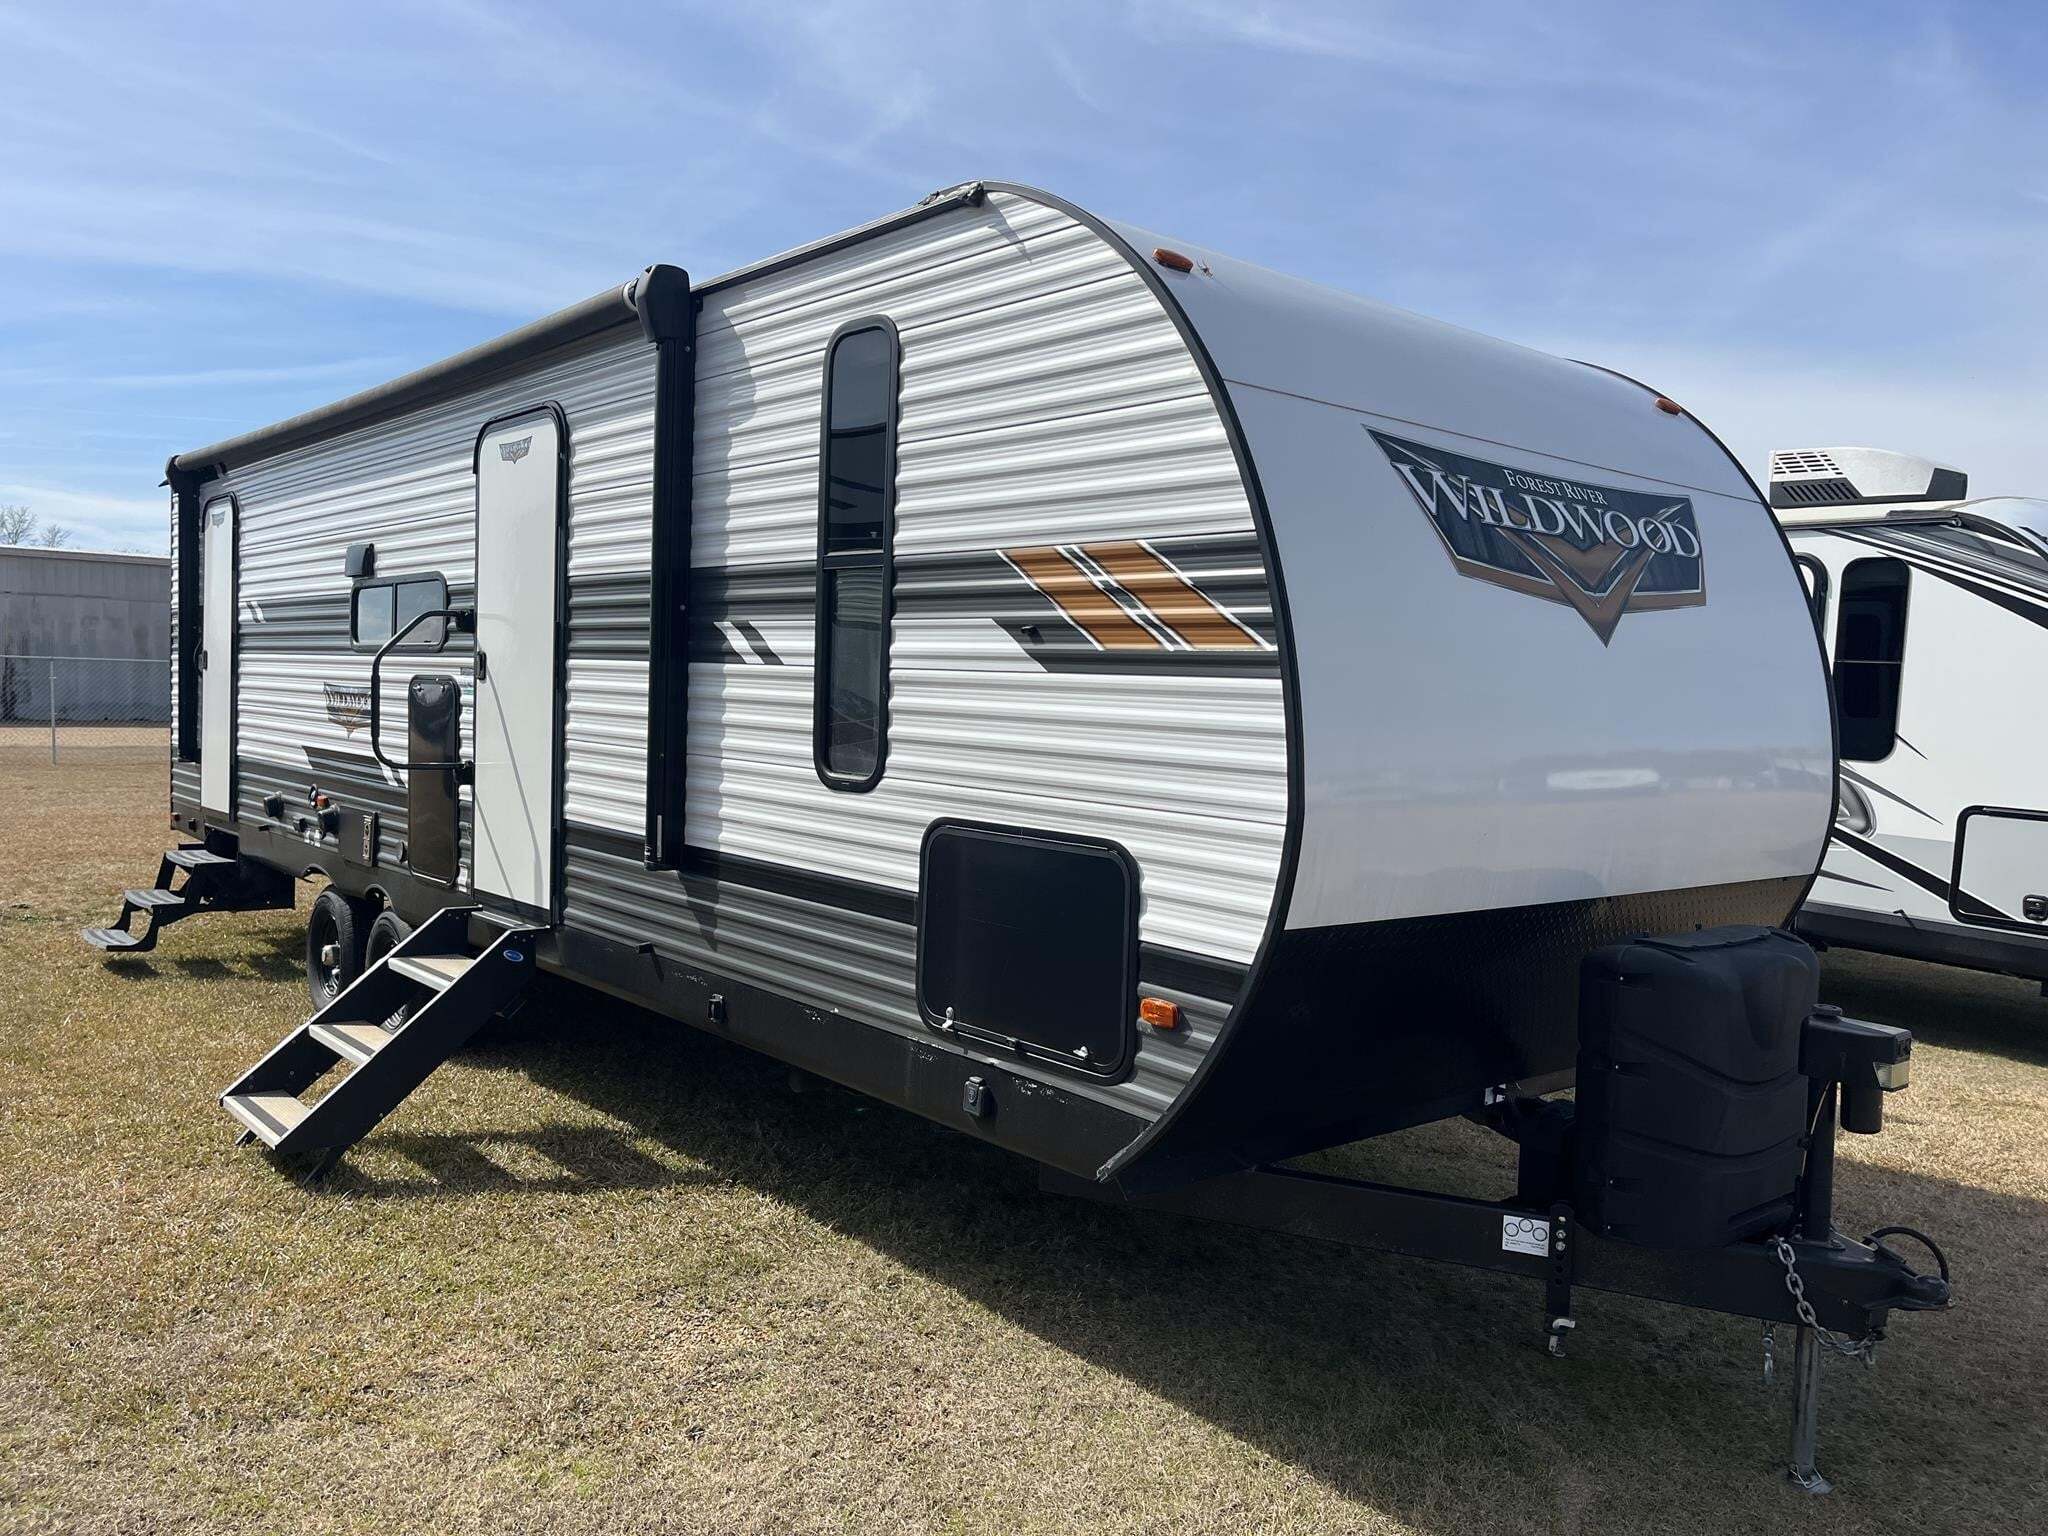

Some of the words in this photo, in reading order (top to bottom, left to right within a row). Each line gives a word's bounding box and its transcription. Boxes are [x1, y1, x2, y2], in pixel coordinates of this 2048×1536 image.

[1390, 462, 1700, 558] WILDWOOD
[1502, 469, 1561, 496] FOREST
[1561, 481, 1608, 505] RIVER
